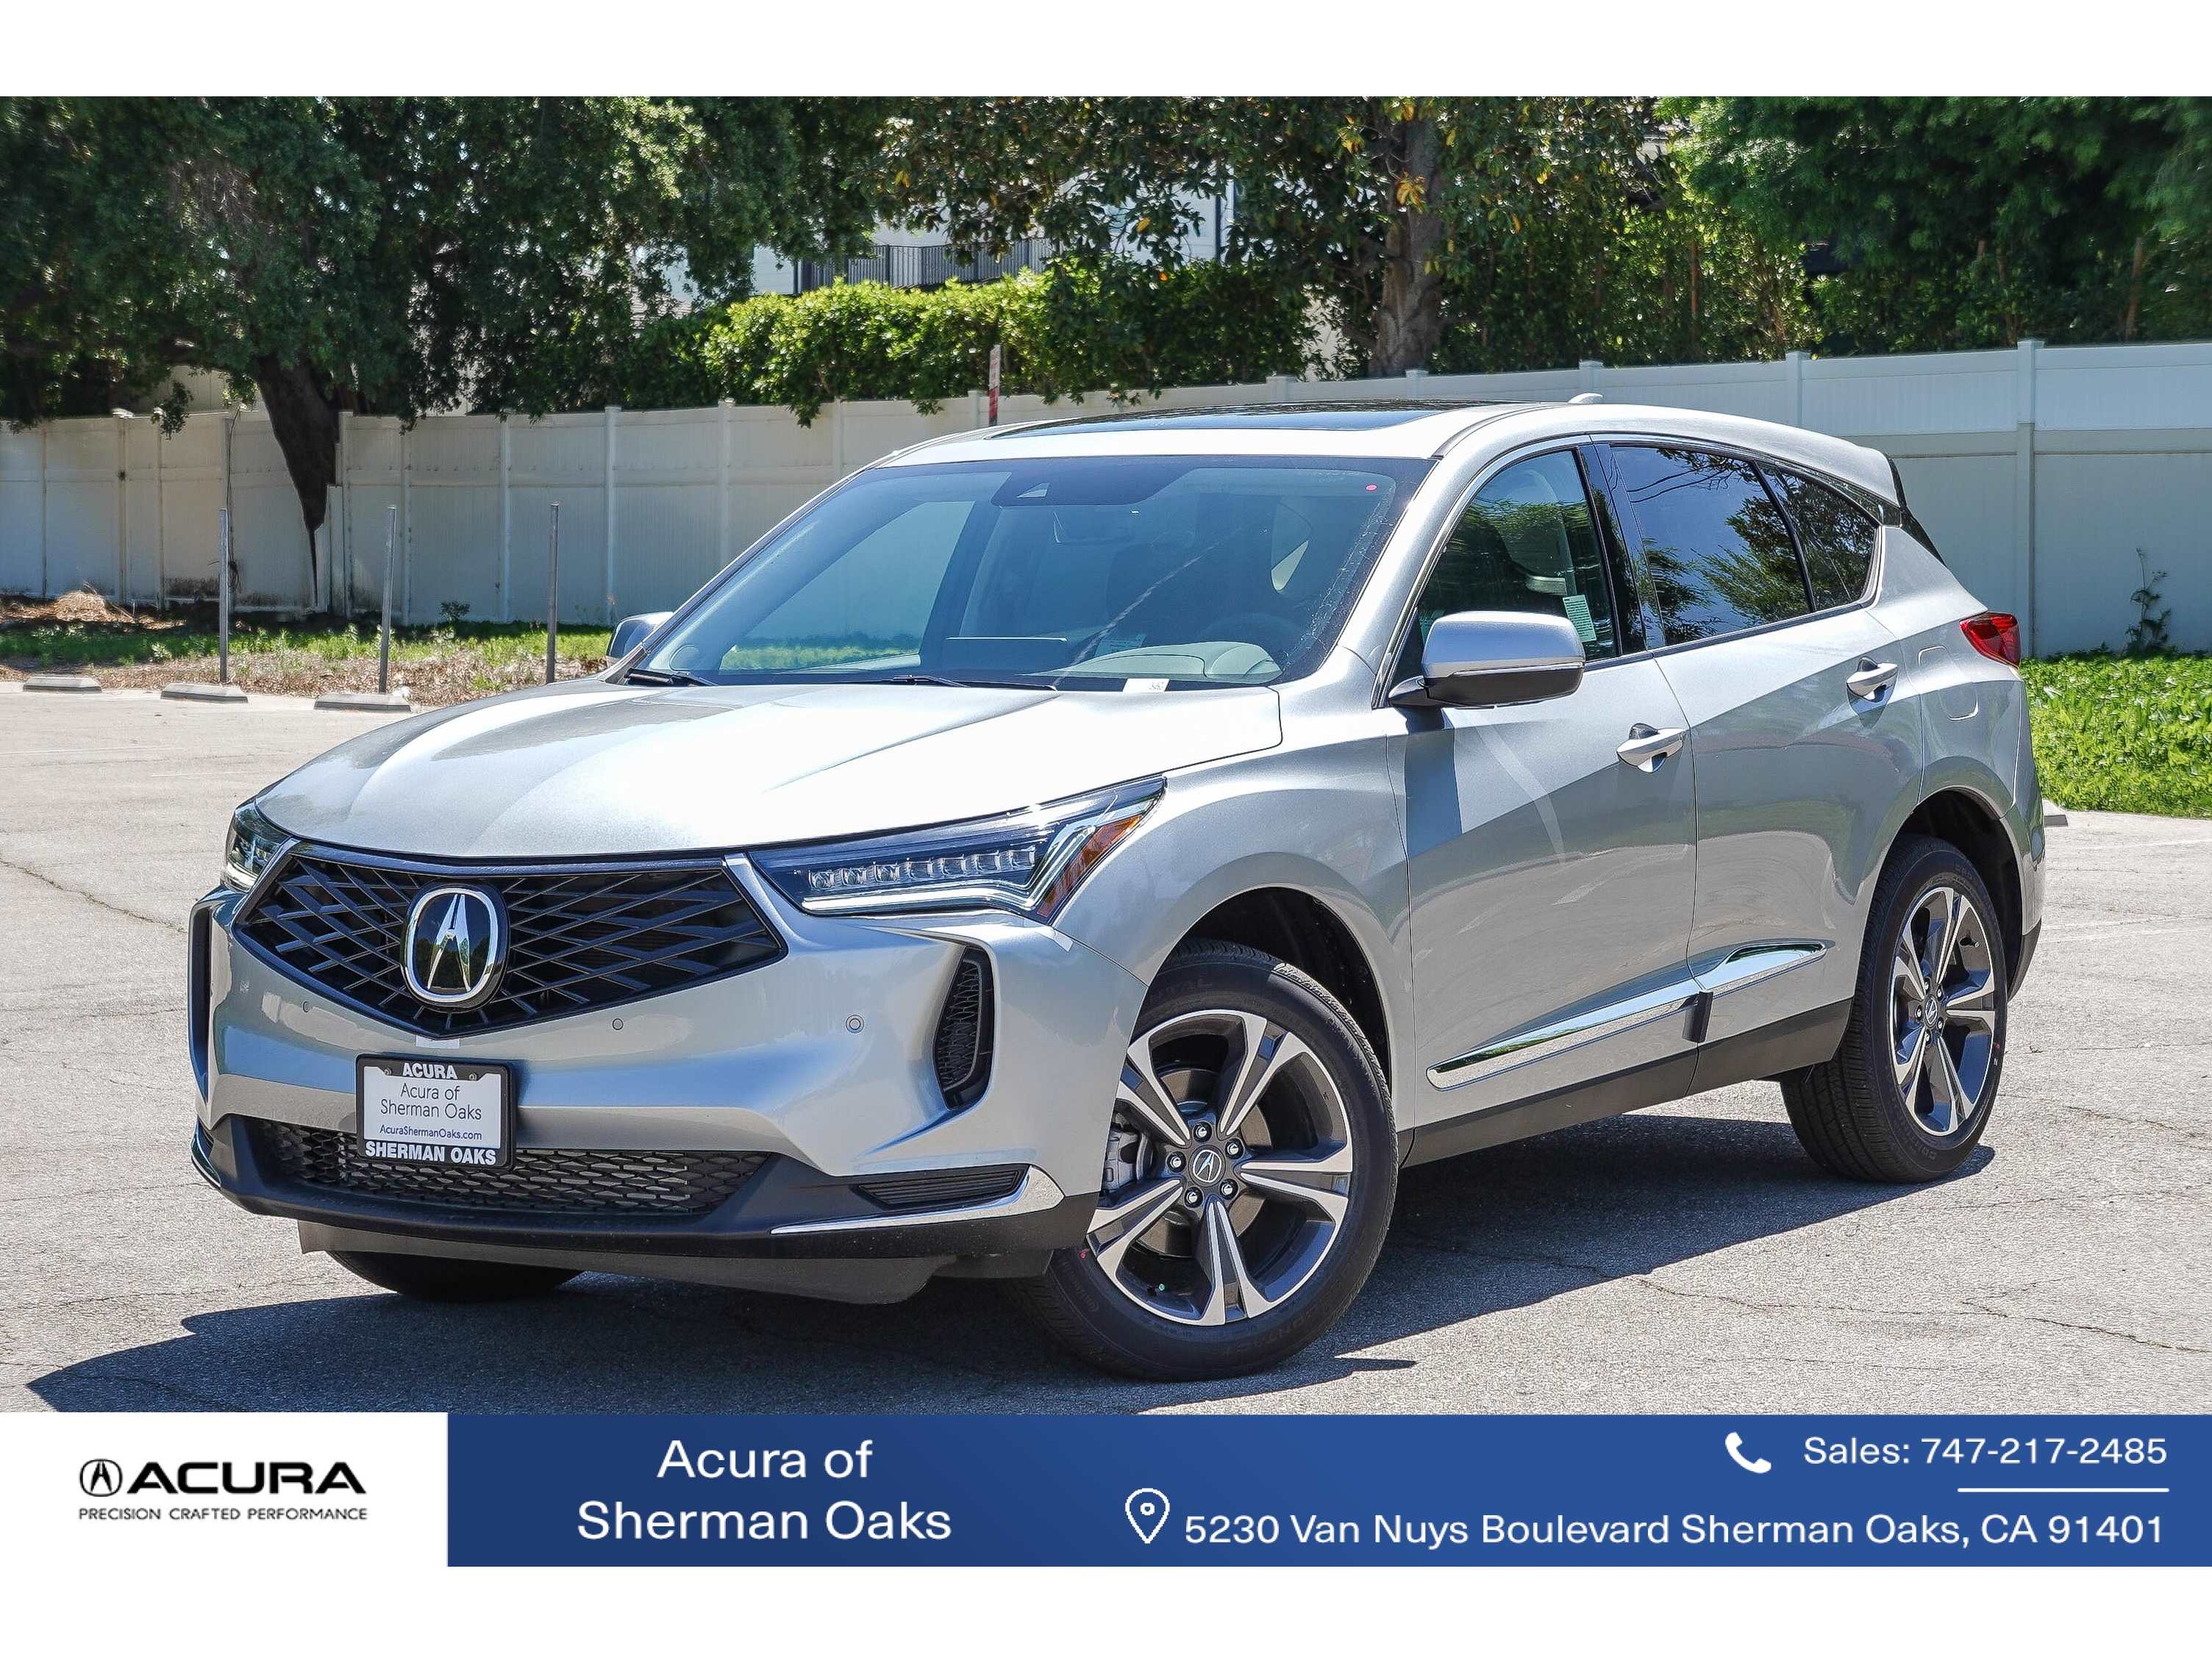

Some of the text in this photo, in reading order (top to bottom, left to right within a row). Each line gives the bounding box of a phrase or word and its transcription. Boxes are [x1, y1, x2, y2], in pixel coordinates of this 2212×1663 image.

[402, 1062, 458, 1080] ACURA
[400, 1083, 460, 1101] Acura of
[380, 1098, 482, 1120] Sherman Oaks
[379, 1124, 482, 1140] AcuraShermanOaks.com
[365, 1140, 496, 1165] SHERMAN OAKS
